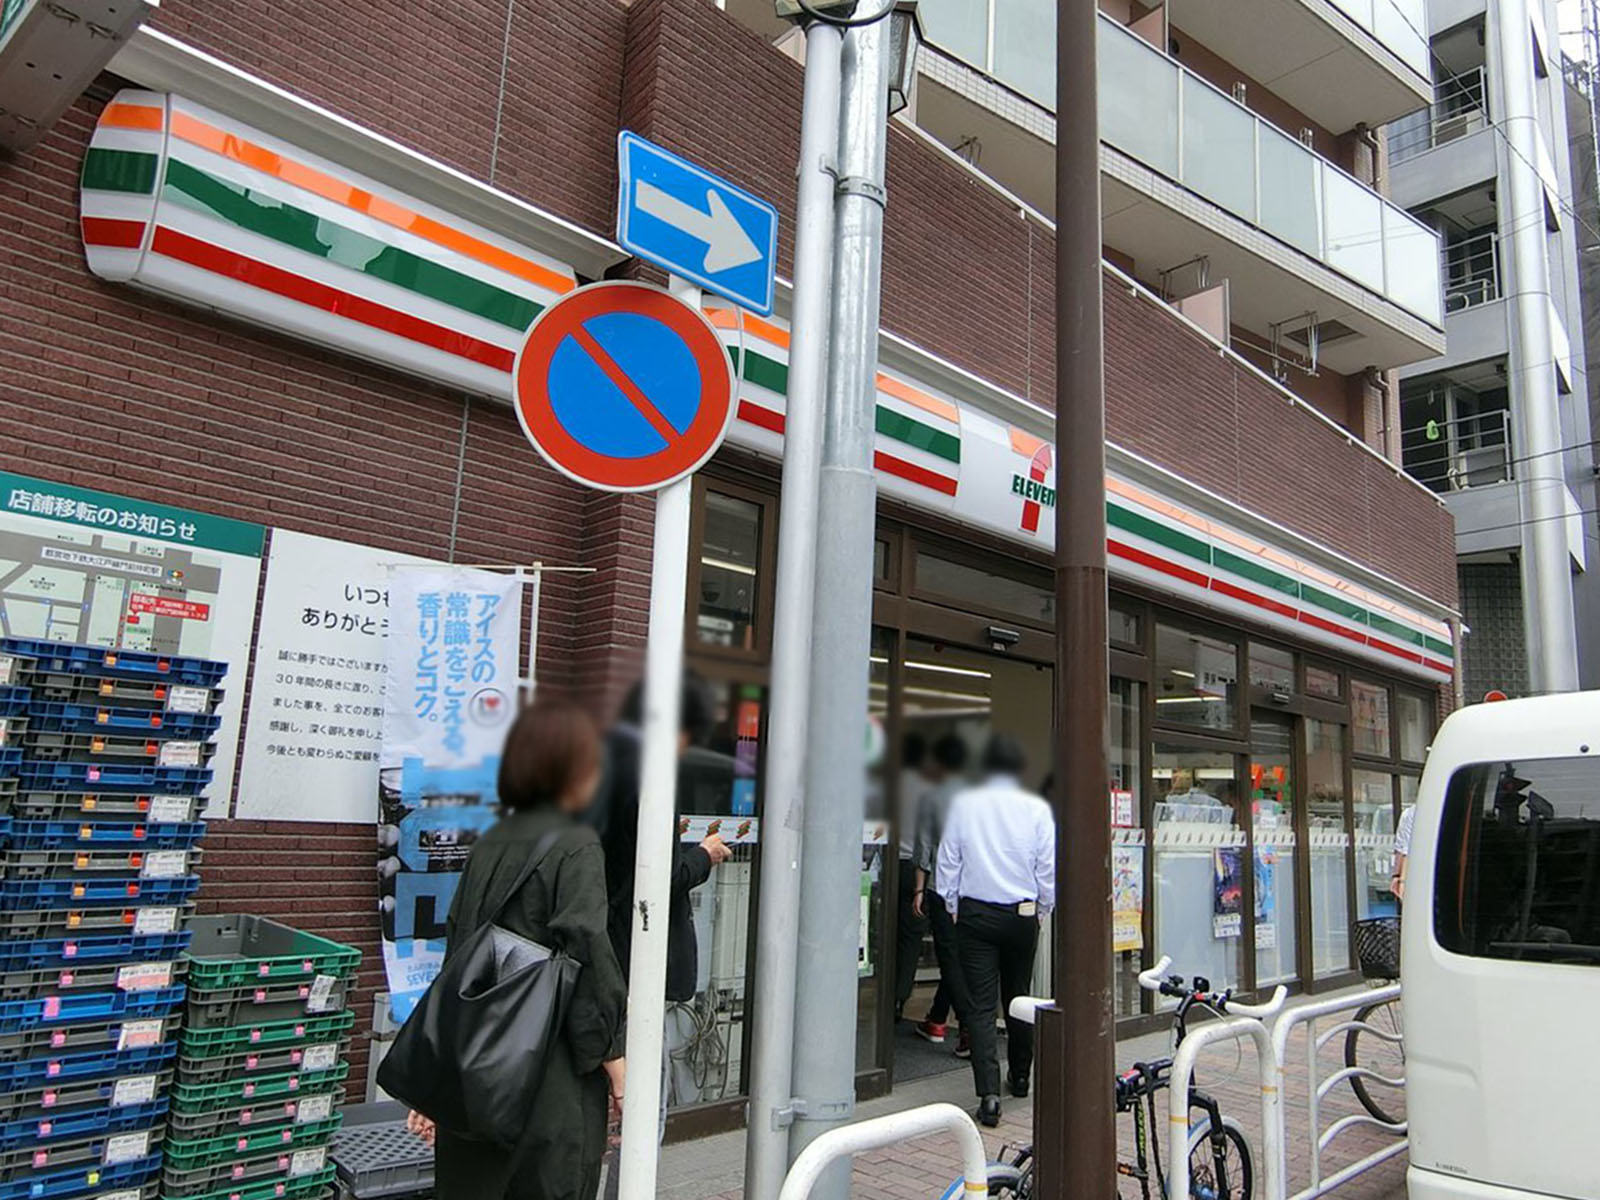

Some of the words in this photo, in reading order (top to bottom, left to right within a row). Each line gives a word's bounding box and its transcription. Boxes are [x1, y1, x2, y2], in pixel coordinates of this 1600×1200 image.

[8, 489, 197, 541] 店舗移転のお知らせ
[414, 592, 443, 722] 香りとコク。
[471, 593, 501, 684] アイスの
[272, 697, 385, 717] ました事を、全てのお客
